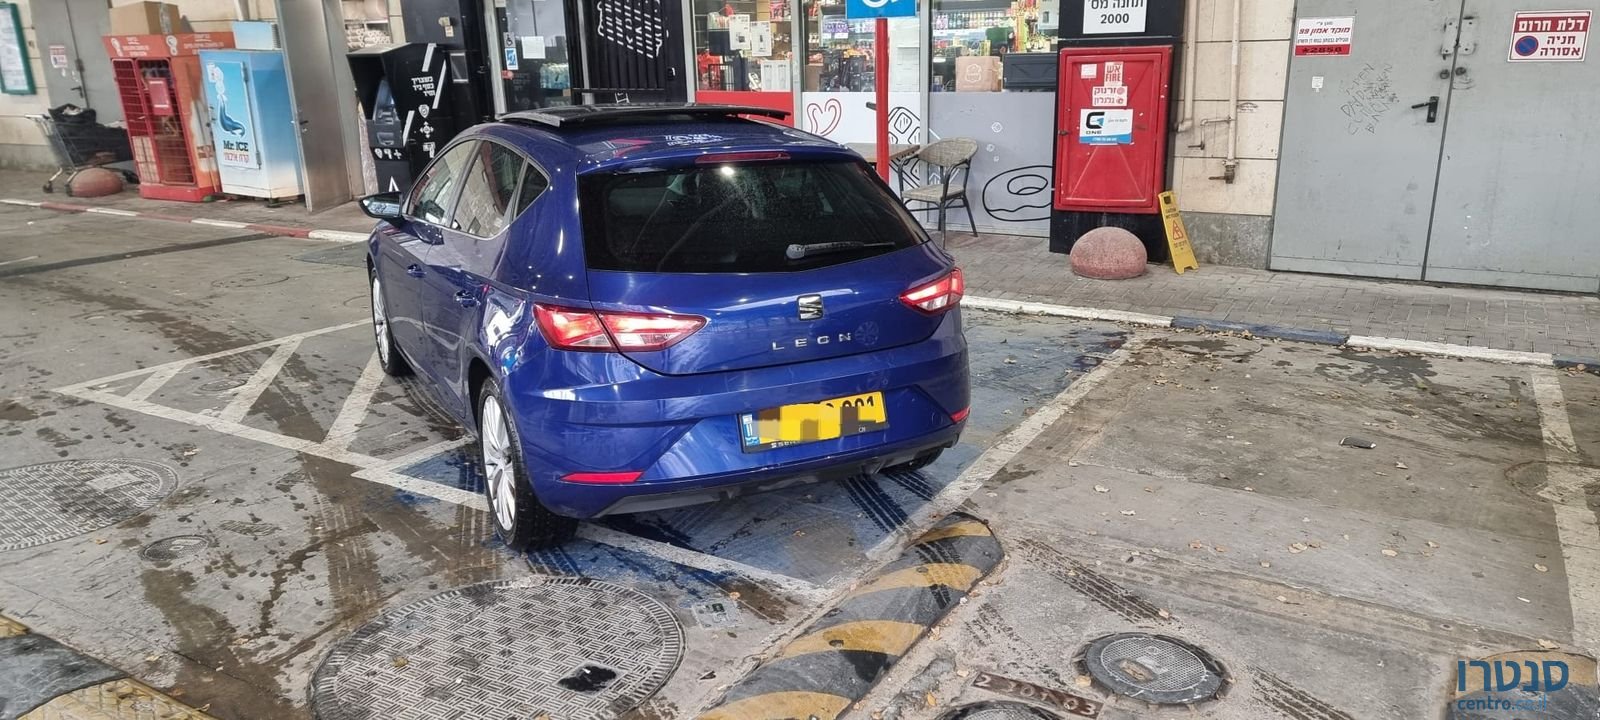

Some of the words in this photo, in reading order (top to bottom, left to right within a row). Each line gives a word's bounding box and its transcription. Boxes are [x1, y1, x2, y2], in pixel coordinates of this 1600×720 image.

[1113, 0, 1143, 8] תחנה
[1100, 13, 1130, 24] 2000
[1519, 20, 1552, 31] חרום
[1557, 17, 1585, 31] דלת
[1310, 28, 1328, 36] אמון
[1547, 35, 1576, 44] חניה
[1540, 47, 1580, 56] אסורה
[1107, 64, 1121, 73] אש
[1105, 73, 1121, 82] FIRE
[1094, 87, 1117, 95] זרנוק
[1094, 97, 1115, 105] גלגלון
[223, 140, 235, 151] Mr.
[236, 142, 249, 152] ICE
[772, 332, 851, 350] LEON
